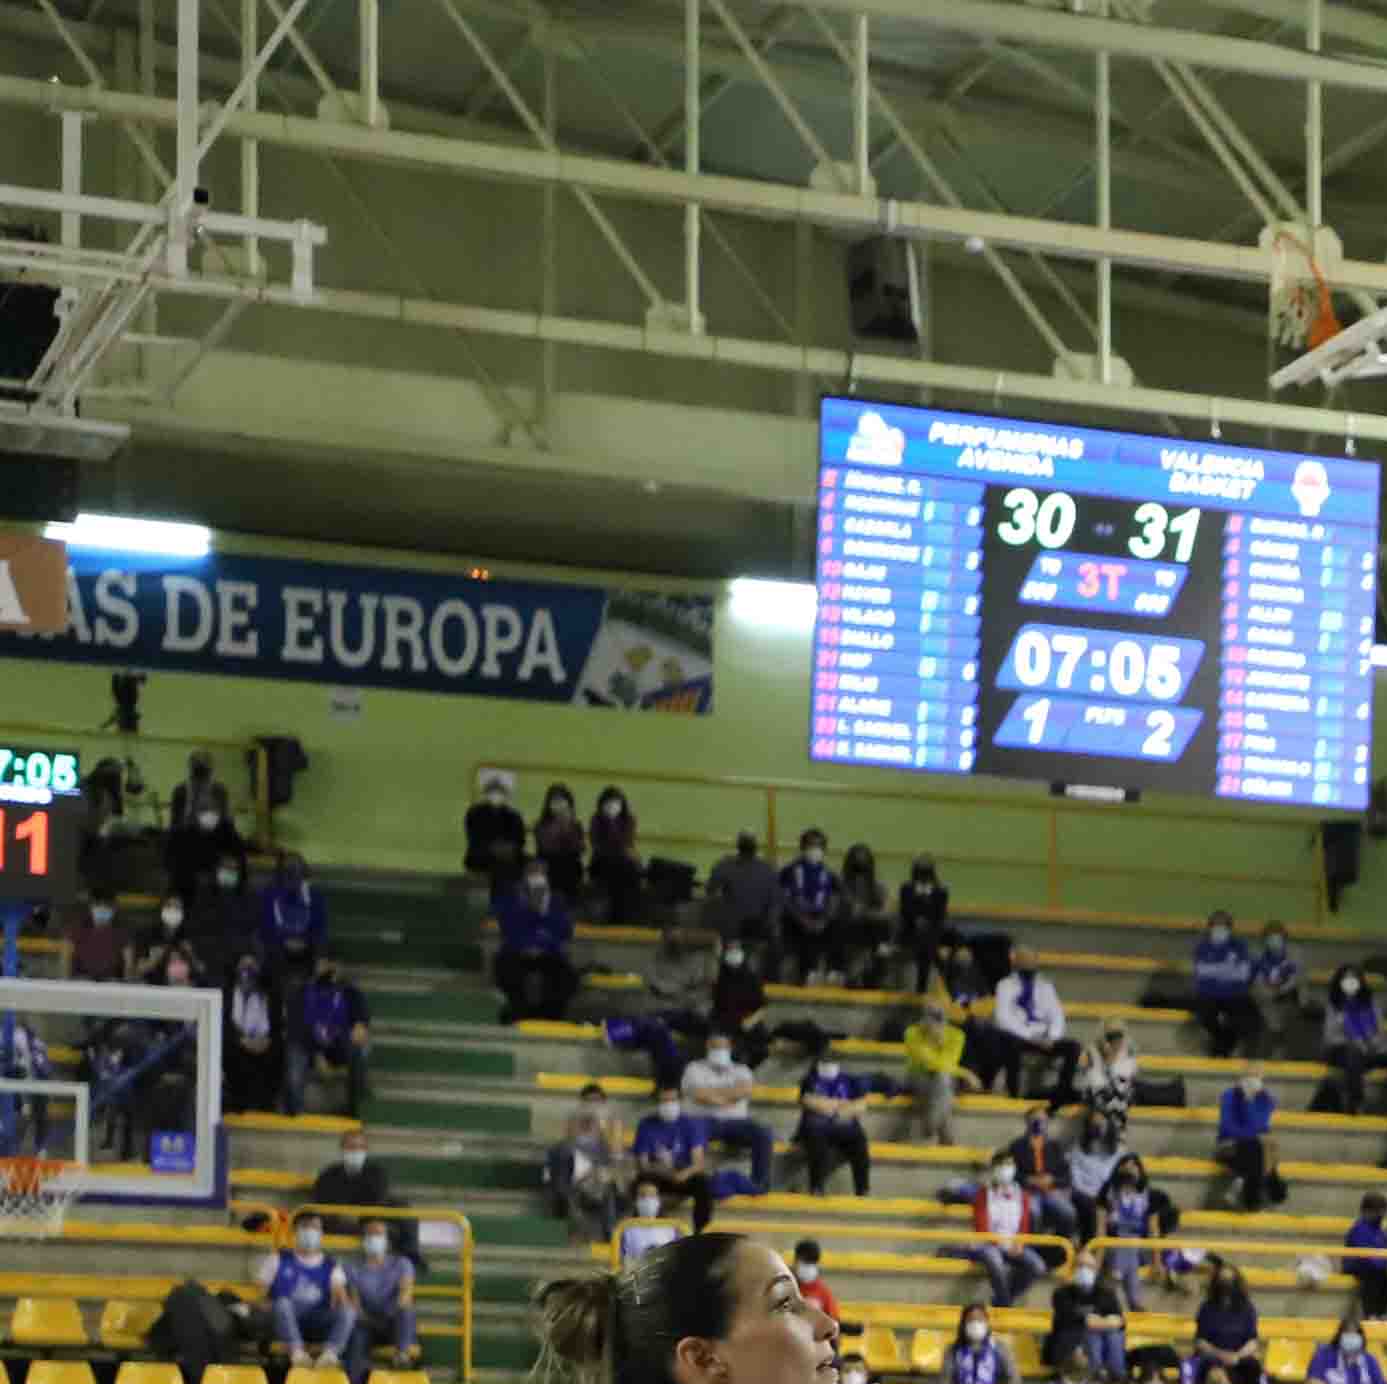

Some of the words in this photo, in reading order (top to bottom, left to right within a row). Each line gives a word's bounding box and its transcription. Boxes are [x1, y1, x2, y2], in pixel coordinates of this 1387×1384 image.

[998, 487, 1076, 549] 30
[1128, 502, 1201, 563] 31
[1076, 561, 1128, 601] 3T
[161, 575, 259, 657] DE
[280, 587, 568, 684] EUROPA
[1013, 631, 1183, 700] 07:05
[1023, 698, 1051, 745] 1
[1141, 709, 1176, 757] 2
